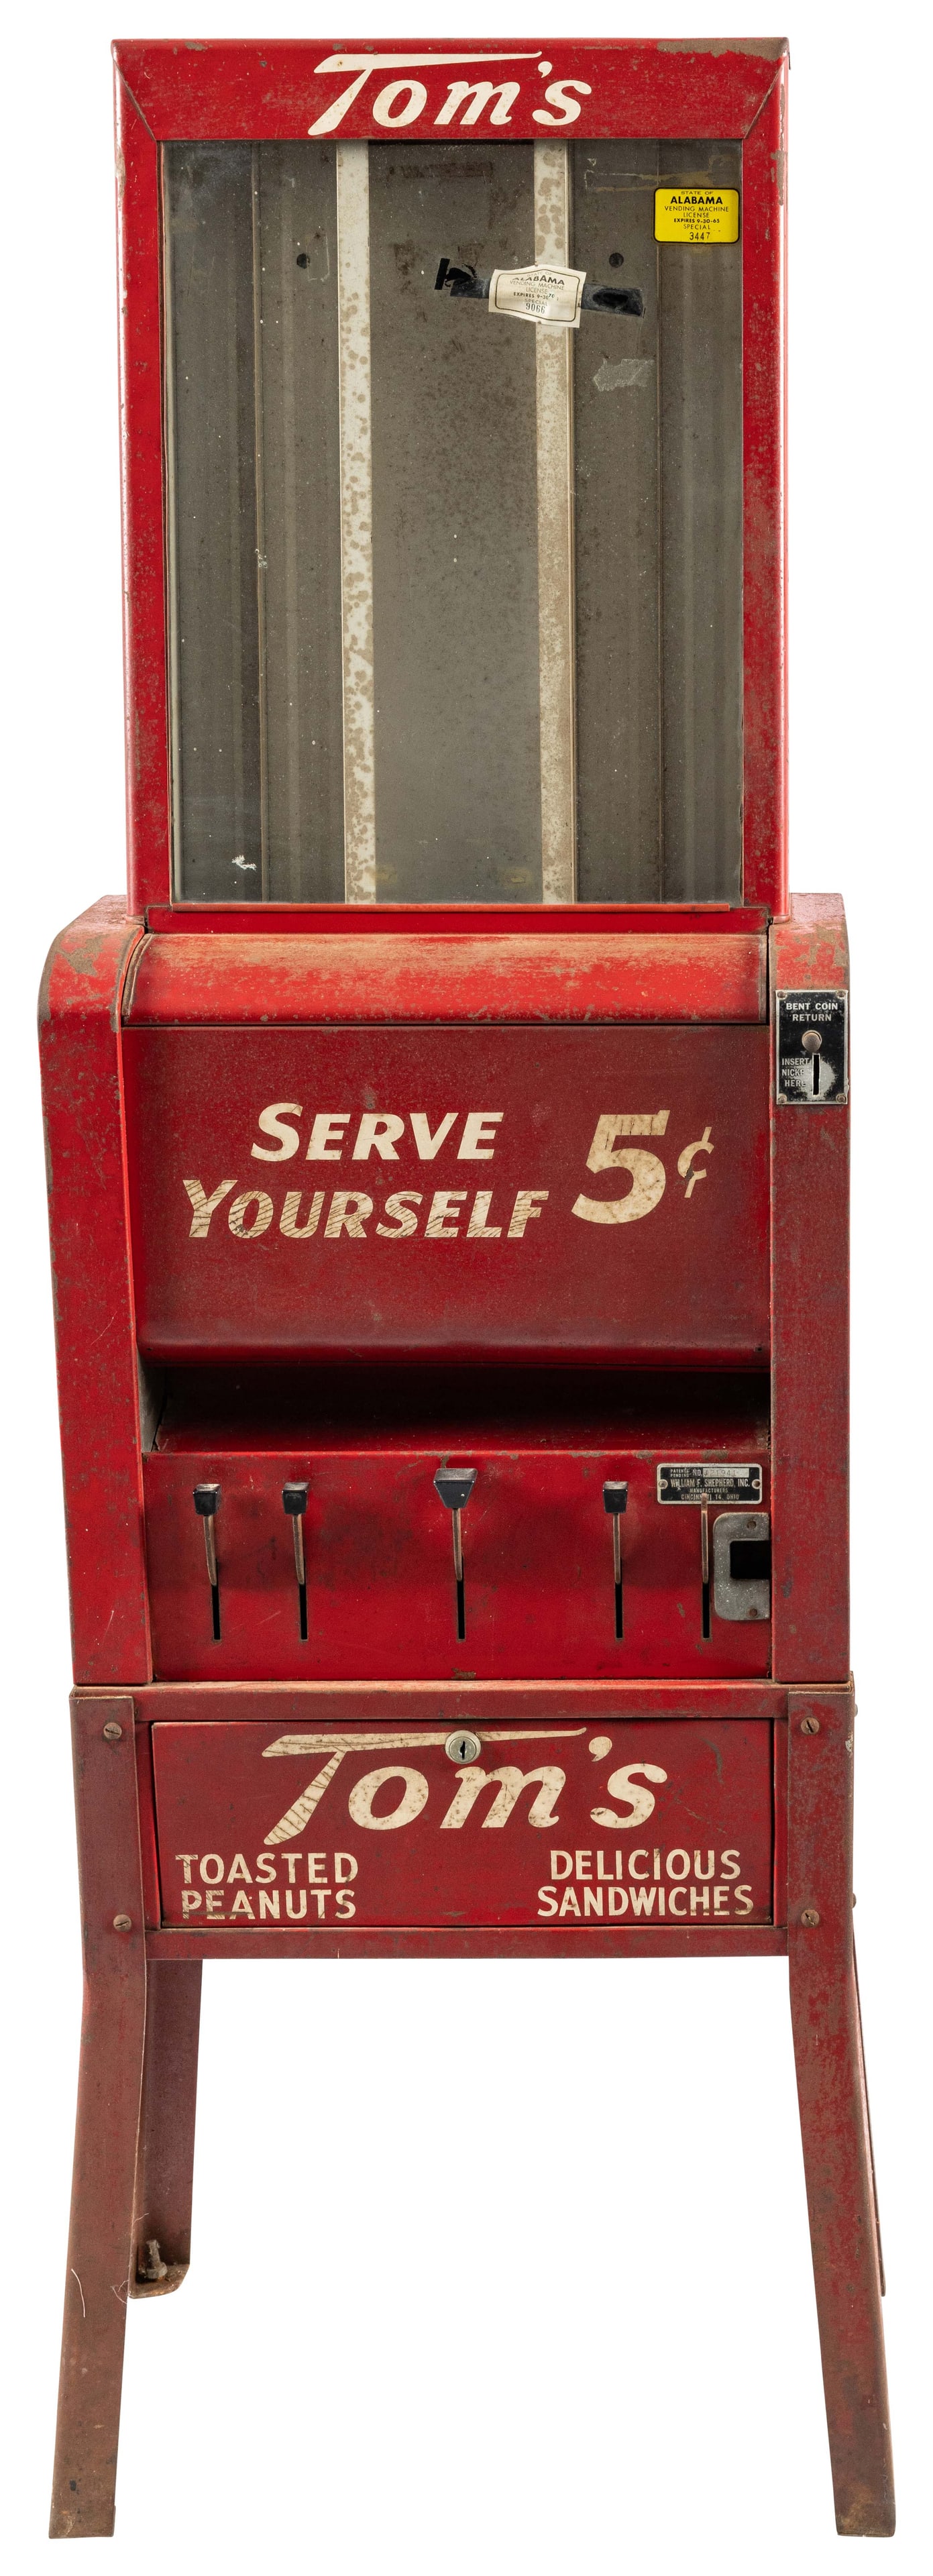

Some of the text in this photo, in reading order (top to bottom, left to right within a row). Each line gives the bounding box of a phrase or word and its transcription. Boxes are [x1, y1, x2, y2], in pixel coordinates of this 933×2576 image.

[308, 51, 592, 136] Tom's
[671, 196, 723, 205] ALABAMA
[689, 231, 710, 240] 3447
[512, 275, 565, 285] ALABAMA
[538, 282, 565, 290] MACHINE
[525, 299, 548, 307] SPECIAL
[525, 303, 545, 314] 9066
[785, 1002, 838, 1010] BENT COIN
[792, 1014, 832, 1022] RETURN
[781, 1057, 810, 1066] INSERT
[781, 1069, 806, 1077] NICKE
[784, 1079, 807, 1087] HERE
[251, 1102, 504, 1161] SERVE
[182, 1179, 549, 1238] YOURSELF
[670, 1478, 750, 1488] WILLIAM F. SHEPHERD, INC.
[262, 1727, 667, 1845] Tom's
[175, 1852, 358, 1886] TOASTED
[550, 1848, 742, 1880] DELICIOUS
[182, 1888, 357, 1921] PEANUTS
[537, 1884, 754, 1917] SANDWICHES
